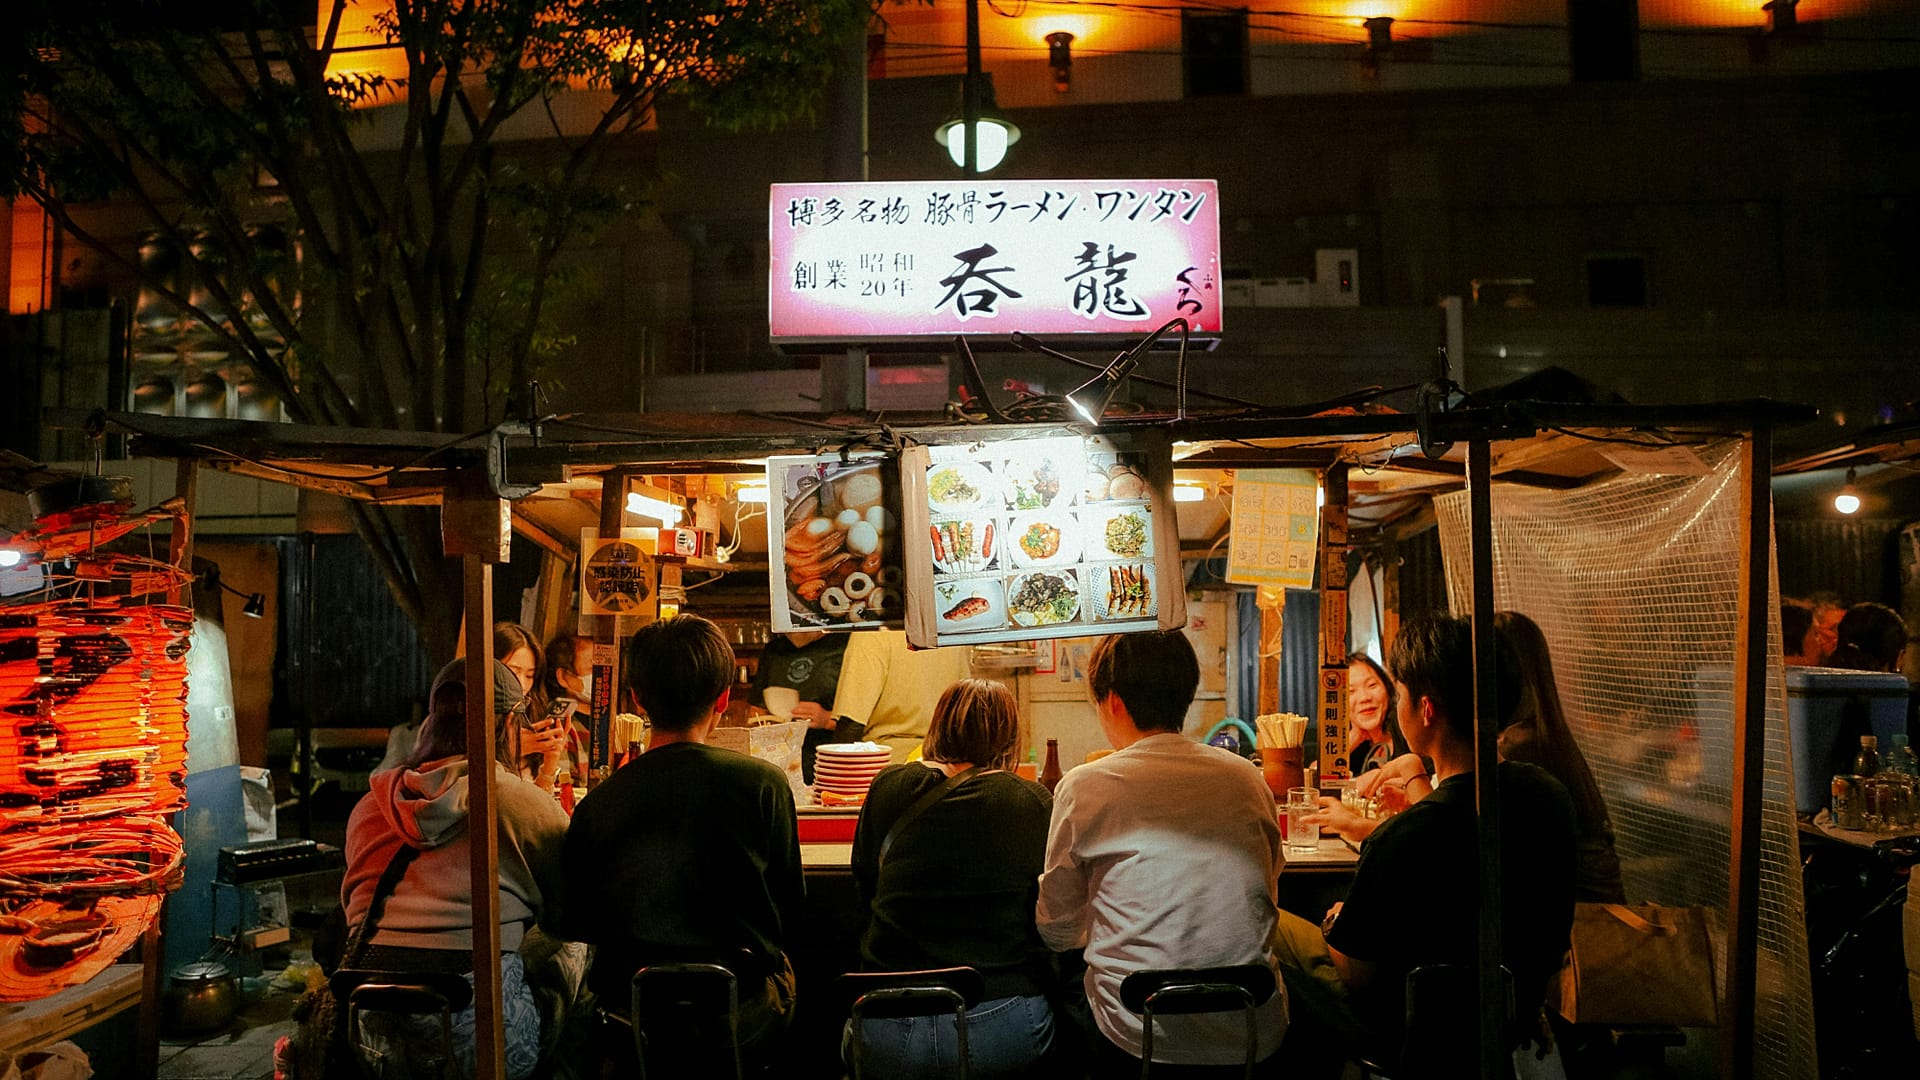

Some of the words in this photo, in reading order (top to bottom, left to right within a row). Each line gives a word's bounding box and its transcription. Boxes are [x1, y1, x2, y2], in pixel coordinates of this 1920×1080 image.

[787, 196, 910, 227] 博多名物
[794, 259, 847, 289] 創業
[860, 252, 914, 273] 昭和
[861, 277, 914, 297] 20年
[593, 566, 645, 579] 感染防止
[1325, 690, 1338, 755] 罰則強化
